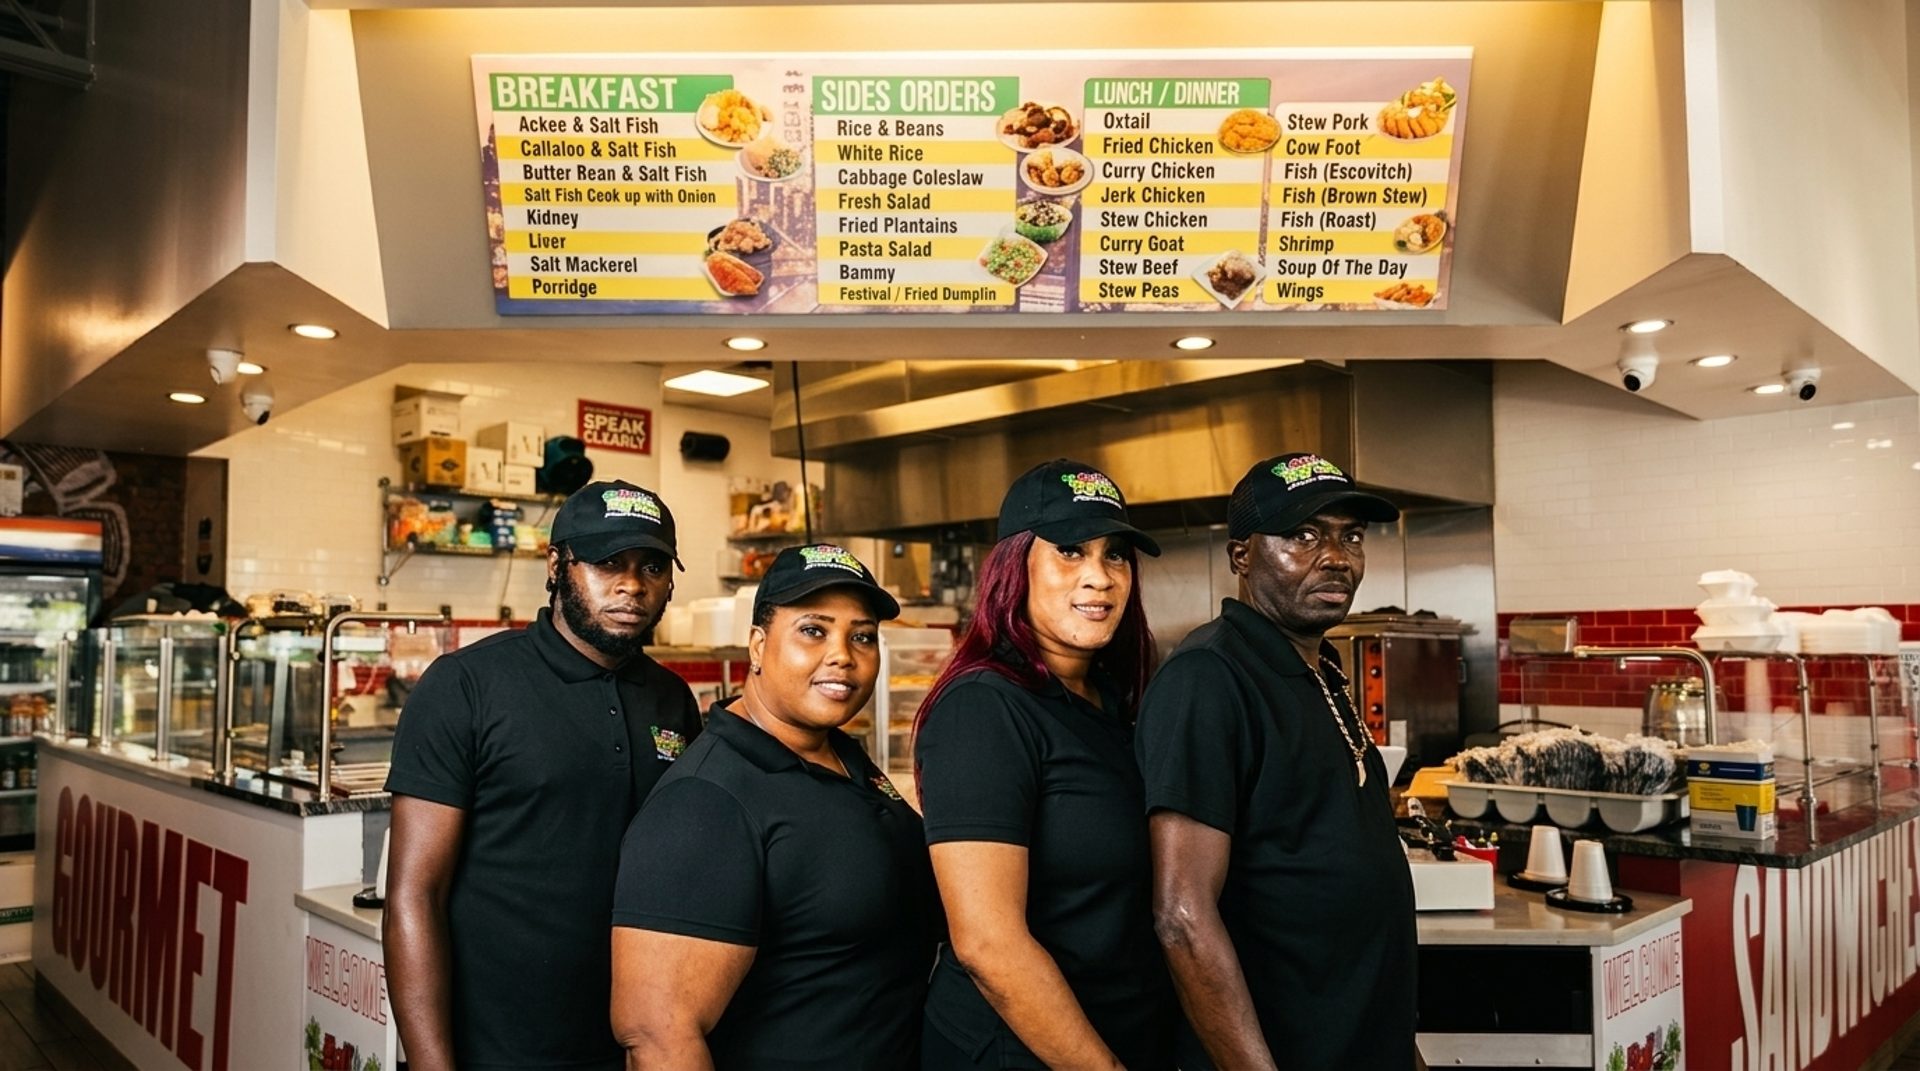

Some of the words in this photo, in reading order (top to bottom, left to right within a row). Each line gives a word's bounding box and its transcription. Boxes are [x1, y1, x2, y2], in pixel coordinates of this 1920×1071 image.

[496, 76, 677, 109] BREAKFAST
[822, 80, 890, 112] SIDES
[900, 80, 995, 112] ORDERS
[1094, 81, 1153, 104] LUNCH
[1158, 81, 1169, 106] /
[1175, 81, 1239, 104] DINNER
[519, 116, 566, 133] Ackee
[573, 116, 584, 133] &
[590, 116, 621, 133] Salt
[626, 117, 658, 134] Fish
[838, 120, 872, 136] Rice
[878, 120, 889, 136] &
[896, 120, 944, 136] Beans
[1104, 112, 1150, 129] Oxtail
[1288, 113, 1327, 130] Stew
[1333, 113, 1368, 130] Pork
[521, 140, 585, 157] Callaloo
[591, 141, 602, 157] &
[608, 141, 639, 158] Salt
[644, 141, 676, 158] Fish
[837, 144, 883, 161] White
[889, 144, 923, 161] Rice
[1103, 137, 1143, 154] Fried
[1149, 137, 1213, 154] Chicken
[1286, 138, 1320, 155] Cow
[1325, 139, 1361, 155] Foot
[523, 164, 571, 181] Butter
[622, 165, 633, 181] &
[639, 165, 670, 182] Salt
[675, 165, 707, 182] Fish
[838, 169, 907, 189] Cabbage
[913, 169, 983, 185] Coleslaw
[1102, 161, 1145, 181] Curry
[1151, 162, 1215, 179] Chicken
[1285, 163, 1317, 179] Fish
[1324, 162, 1412, 182] (Escovitch)
[524, 187, 551, 202] Salt
[555, 188, 582, 202] Fish
[625, 192, 641, 206] up
[645, 189, 673, 203] with
[839, 193, 881, 209] Fresh
[887, 193, 930, 210] Salad
[1101, 186, 1136, 203] Jerk
[1142, 186, 1205, 203] Chicken
[1283, 187, 1315, 204] Fish
[1321, 187, 1377, 207] (Brown
[1382, 187, 1427, 207] Stew)
[527, 209, 578, 229] Kidney
[839, 217, 878, 233] Fried
[884, 217, 957, 234] Plantains
[1101, 211, 1139, 227] Stew
[1144, 211, 1207, 228] Chicken
[1281, 211, 1314, 228] Fish
[1320, 211, 1376, 231] (Roast)
[529, 233, 566, 249] Liver
[839, 241, 883, 257] Pasta
[889, 241, 931, 257] Salad
[1100, 235, 1143, 254] Curry
[1148, 235, 1184, 252] Goat
[1279, 235, 1334, 255] Shrimp
[531, 256, 561, 272] Salt
[566, 256, 637, 273] Mackerel
[840, 264, 895, 284] Bammy
[1099, 259, 1137, 275] Stew
[1143, 259, 1178, 275] Beef
[1278, 259, 1316, 278] Soup
[1322, 259, 1340, 275] Of
[1345, 259, 1373, 275] The
[1379, 259, 1408, 279] Day
[532, 278, 597, 298] Porridge
[840, 287, 891, 300] Festival
[895, 287, 901, 301] /
[905, 287, 938, 301] Fried
[943, 287, 996, 304] Dumplin
[1099, 282, 1136, 298] Stew
[1142, 282, 1179, 298] Peas
[1277, 282, 1324, 302] Wings
[583, 413, 646, 438] SPEAK
[52, 785, 249, 1071] GOURMET
[306, 936, 387, 1025] WELCOME
[1603, 931, 1681, 1020] WELCOME
